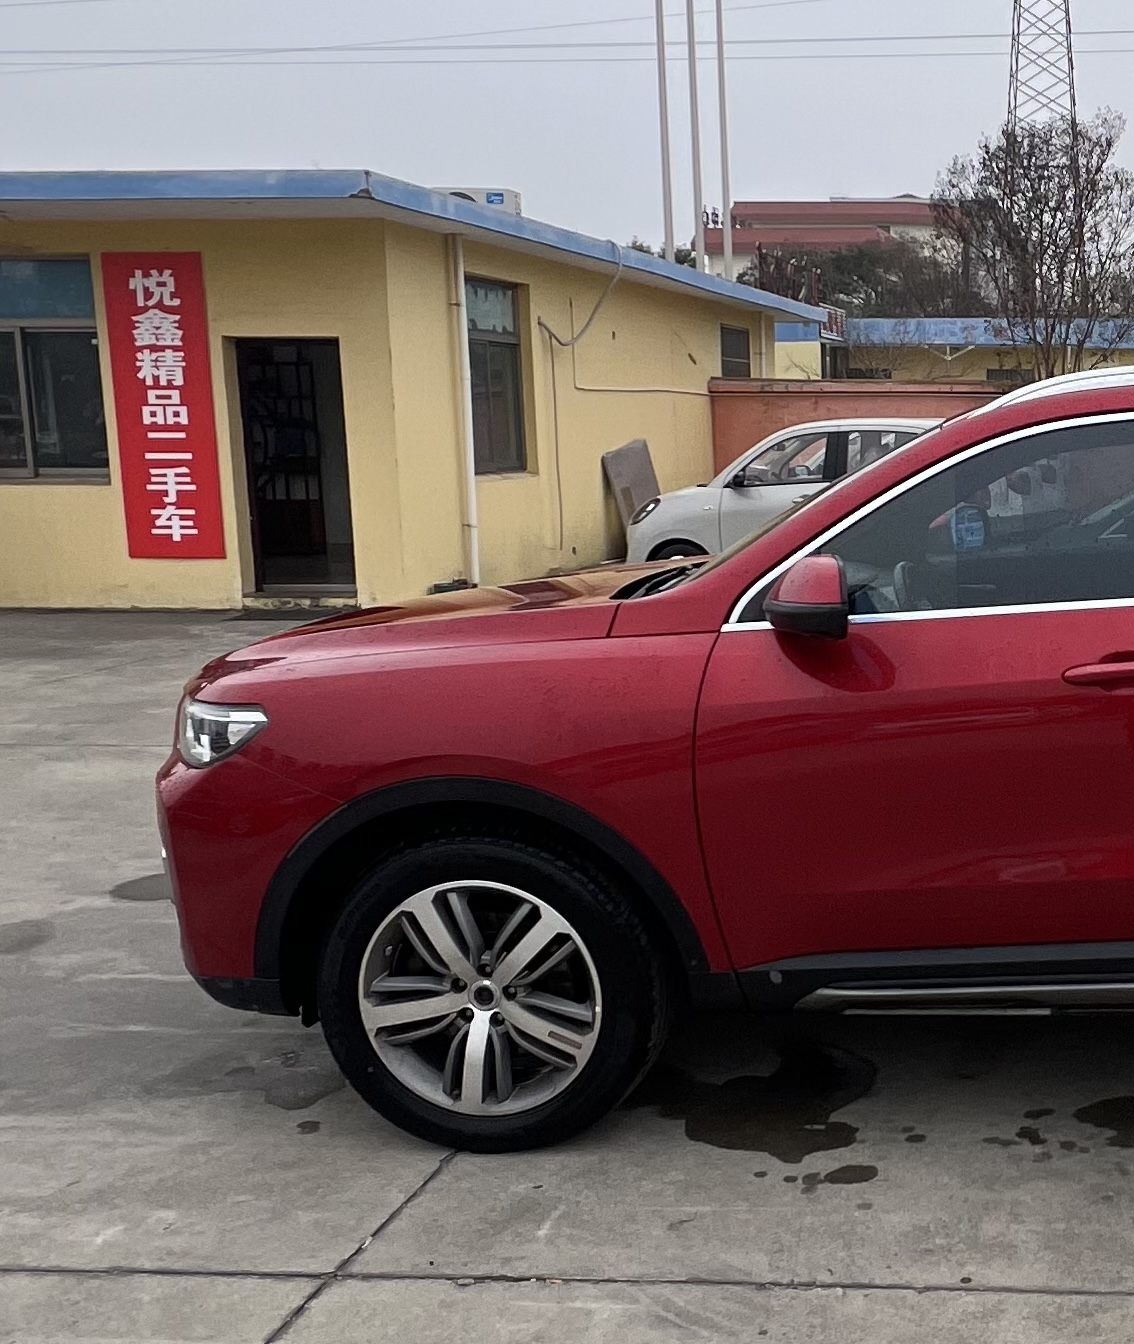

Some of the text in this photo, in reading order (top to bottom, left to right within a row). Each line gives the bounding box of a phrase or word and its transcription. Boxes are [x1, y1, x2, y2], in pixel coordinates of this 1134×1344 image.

[129, 269, 199, 542] 悦鑫精品二手车
